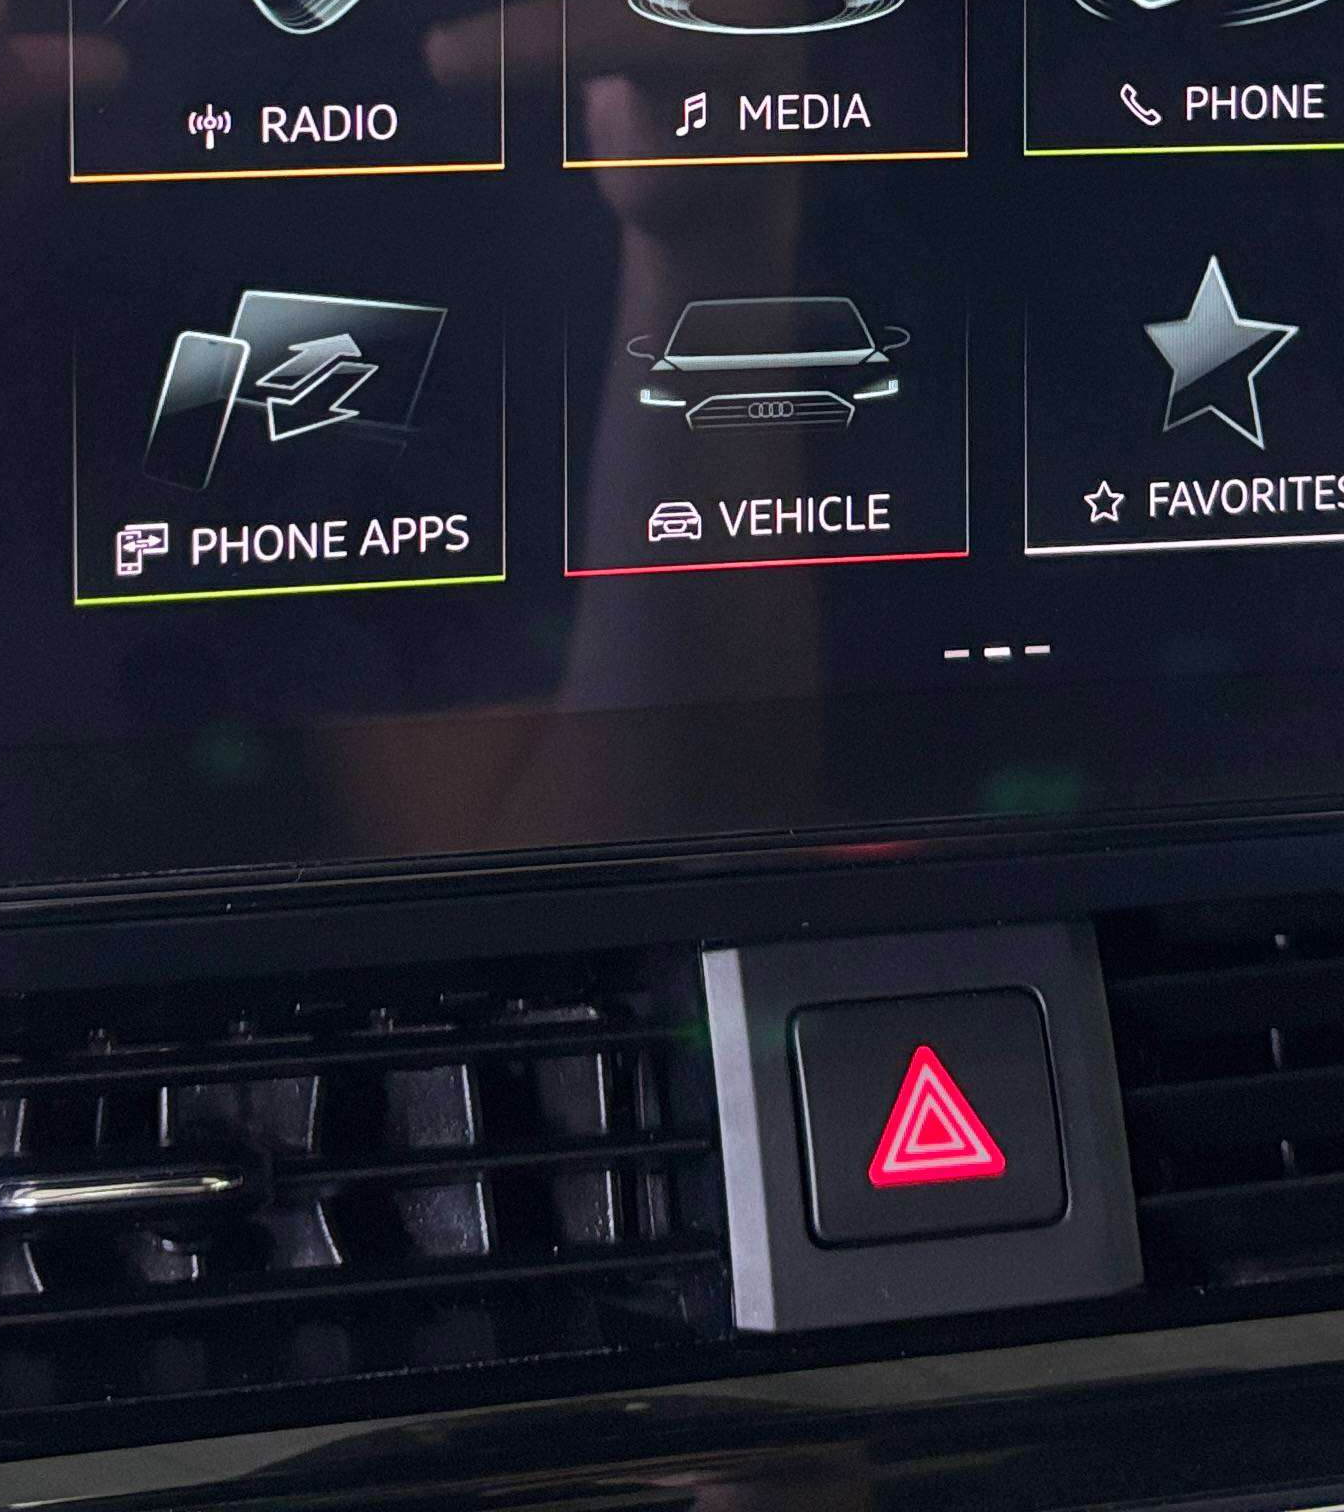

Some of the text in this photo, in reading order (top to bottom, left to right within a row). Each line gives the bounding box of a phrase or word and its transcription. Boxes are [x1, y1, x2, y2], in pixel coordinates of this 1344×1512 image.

[739, 92, 872, 131] MEDIA
[1186, 83, 1325, 121] PHONE
[262, 103, 397, 144] RADIO
[718, 493, 891, 537] VEHICLE
[191, 514, 470, 566] PHONE APPS
